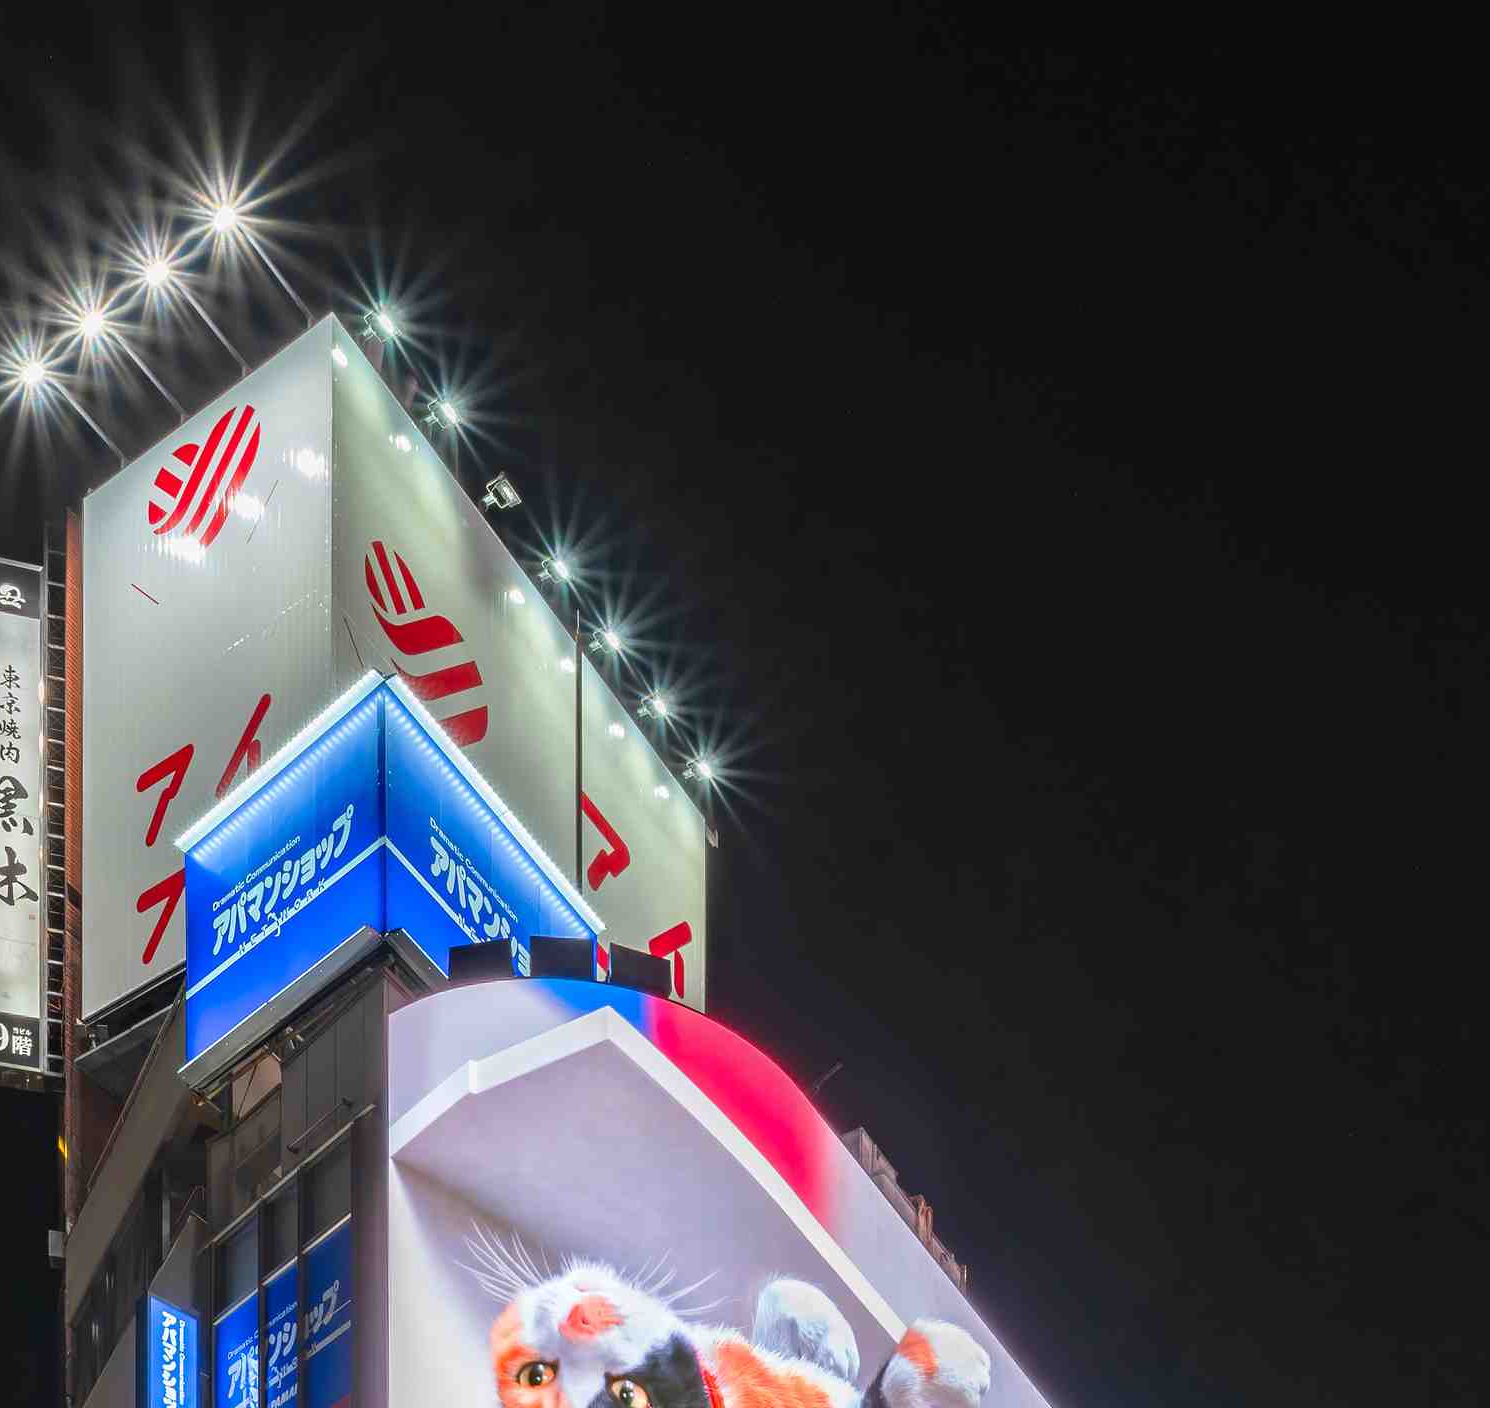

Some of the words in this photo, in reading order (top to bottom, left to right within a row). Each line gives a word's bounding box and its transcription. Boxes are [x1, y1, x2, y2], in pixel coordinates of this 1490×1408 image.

[212, 880, 246, 912] Dramatic
[245, 835, 302, 884] Communication
[212, 803, 354, 956] アパマンショップ
[429, 815, 465, 862] Dramatic
[464, 857, 519, 923] Communication
